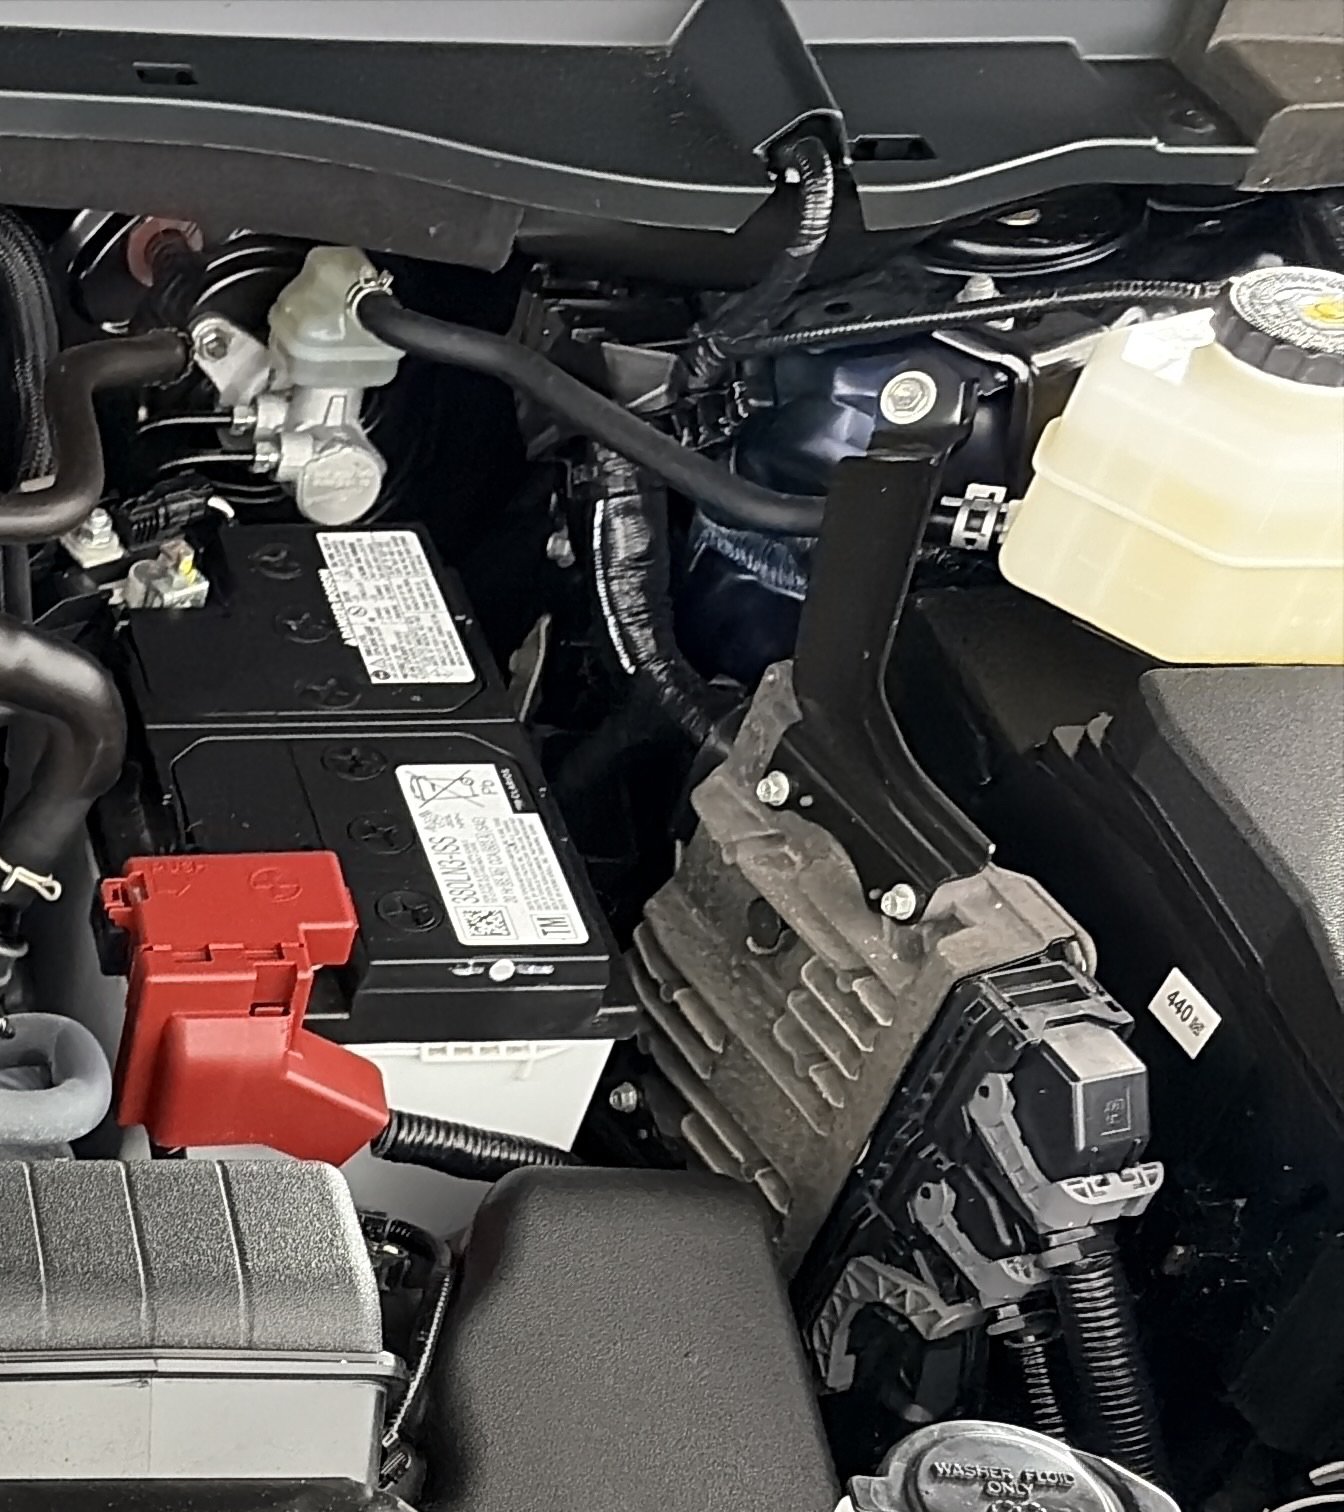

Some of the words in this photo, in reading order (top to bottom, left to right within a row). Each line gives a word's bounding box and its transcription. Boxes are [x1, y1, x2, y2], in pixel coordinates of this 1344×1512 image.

[1167, 990, 1194, 1022] 440
[931, 1461, 1014, 1481] WASHER
[986, 1480, 1034, 1497] ONLY
